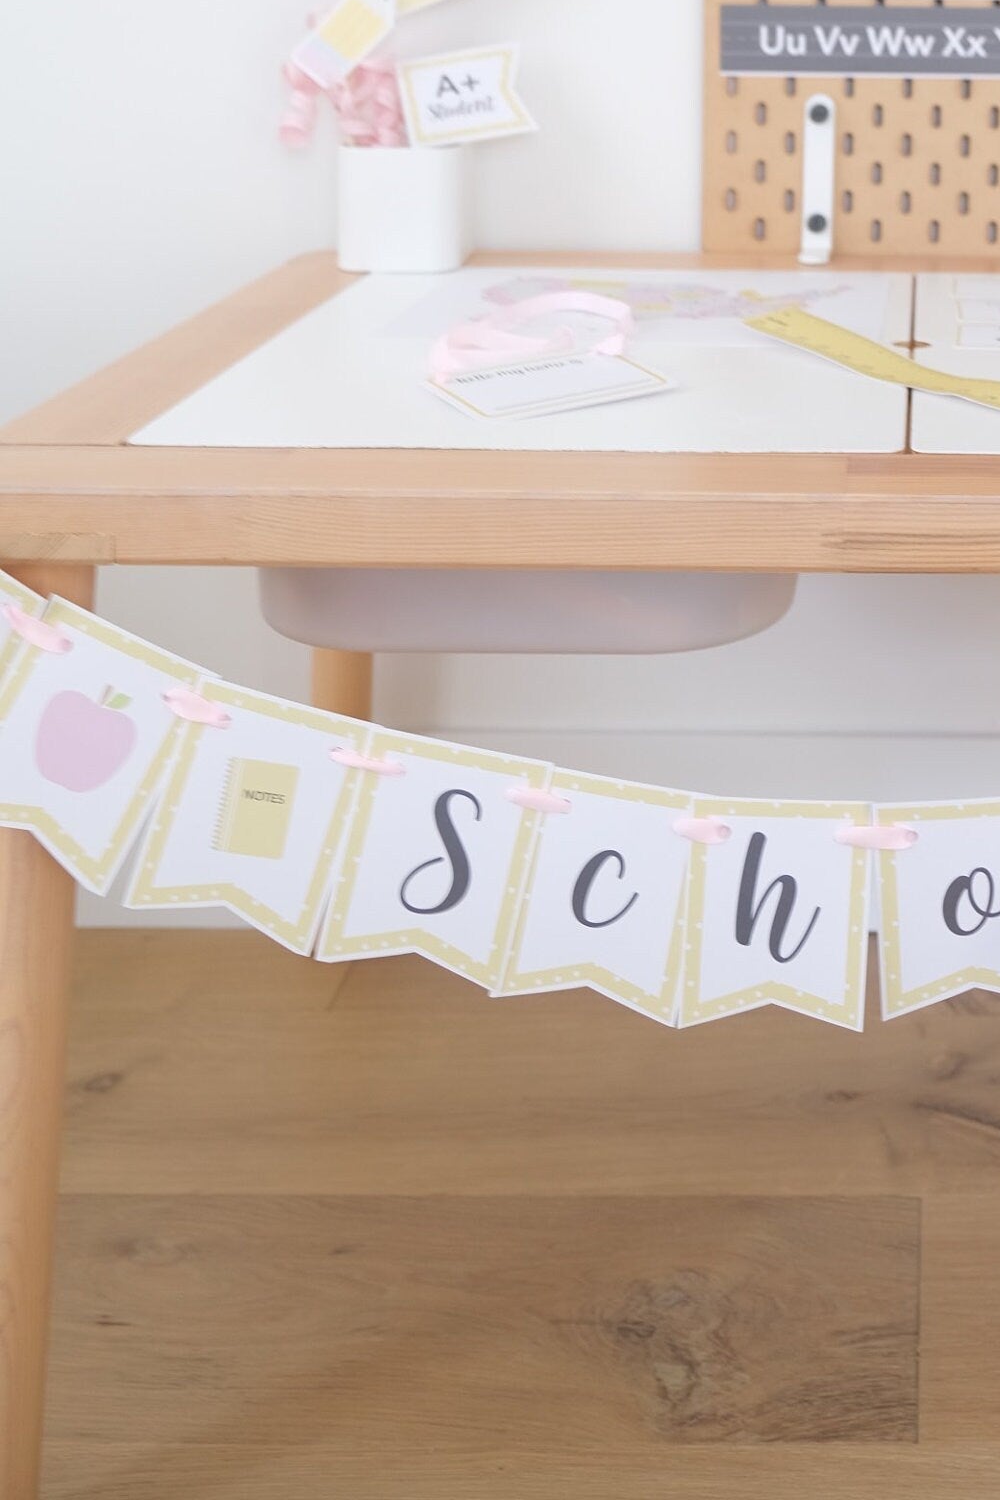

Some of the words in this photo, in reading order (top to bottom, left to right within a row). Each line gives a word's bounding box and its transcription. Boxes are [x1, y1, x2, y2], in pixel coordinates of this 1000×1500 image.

[760, 26, 806, 55] Uu
[815, 26, 859, 55] Vv
[866, 26, 935, 57] Ww
[943, 28, 986, 57] Xx
[437, 75, 479, 98] A+
[242, 788, 287, 806] NOTES
